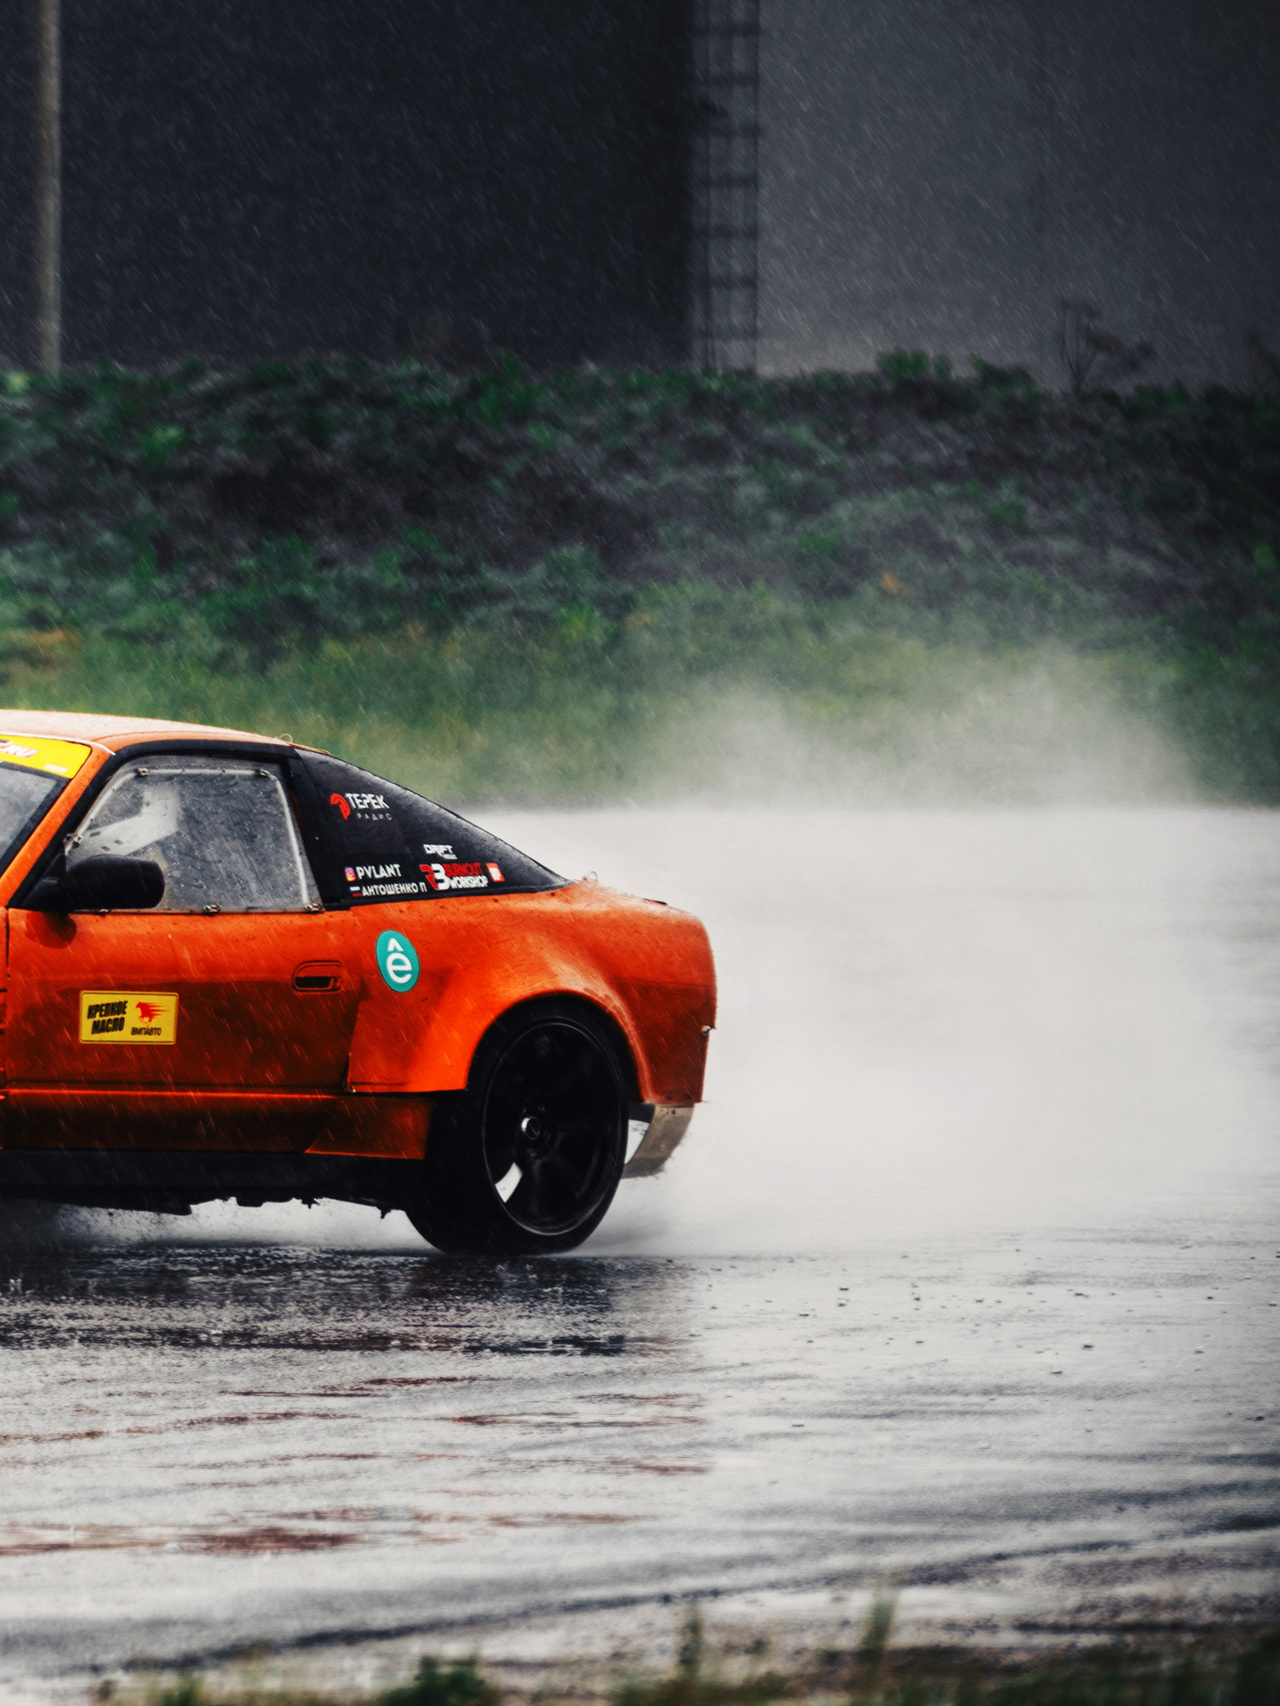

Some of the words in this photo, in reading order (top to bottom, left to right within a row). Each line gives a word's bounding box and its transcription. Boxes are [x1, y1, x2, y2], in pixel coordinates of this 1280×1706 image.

[345, 793, 390, 809] ТЕРЕК
[356, 864, 402, 880] PVLANT
[441, 862, 483, 877] BURNOUT
[361, 882, 419, 896] АНТОШЕНКО
[449, 875, 488, 889] WORKSHOP
